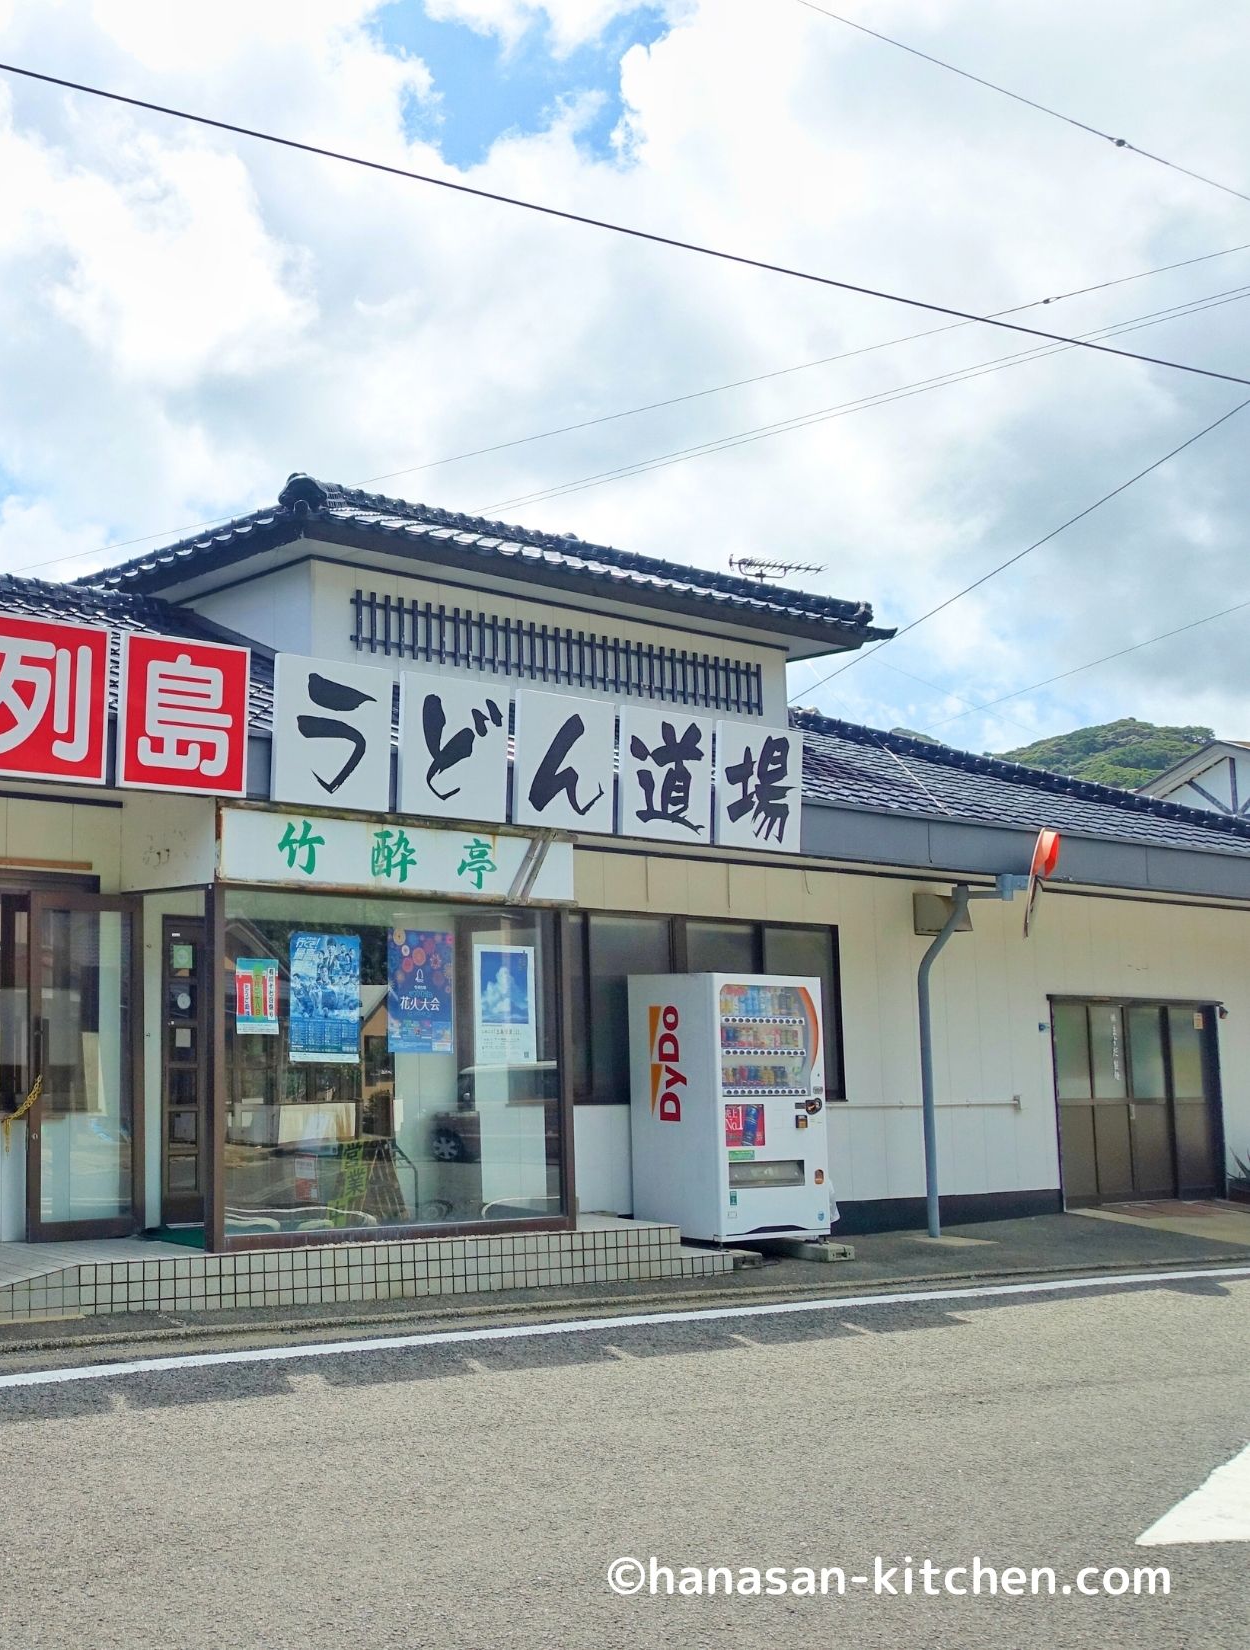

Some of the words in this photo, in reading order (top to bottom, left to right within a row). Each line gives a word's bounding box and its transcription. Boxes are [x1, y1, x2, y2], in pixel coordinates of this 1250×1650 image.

[296, 672, 799, 846] うどん道場
[277, 818, 498, 890] 竹酔亭
[399, 995, 441, 1011] 花火大会
[658, 1005, 688, 1123] DyDo
